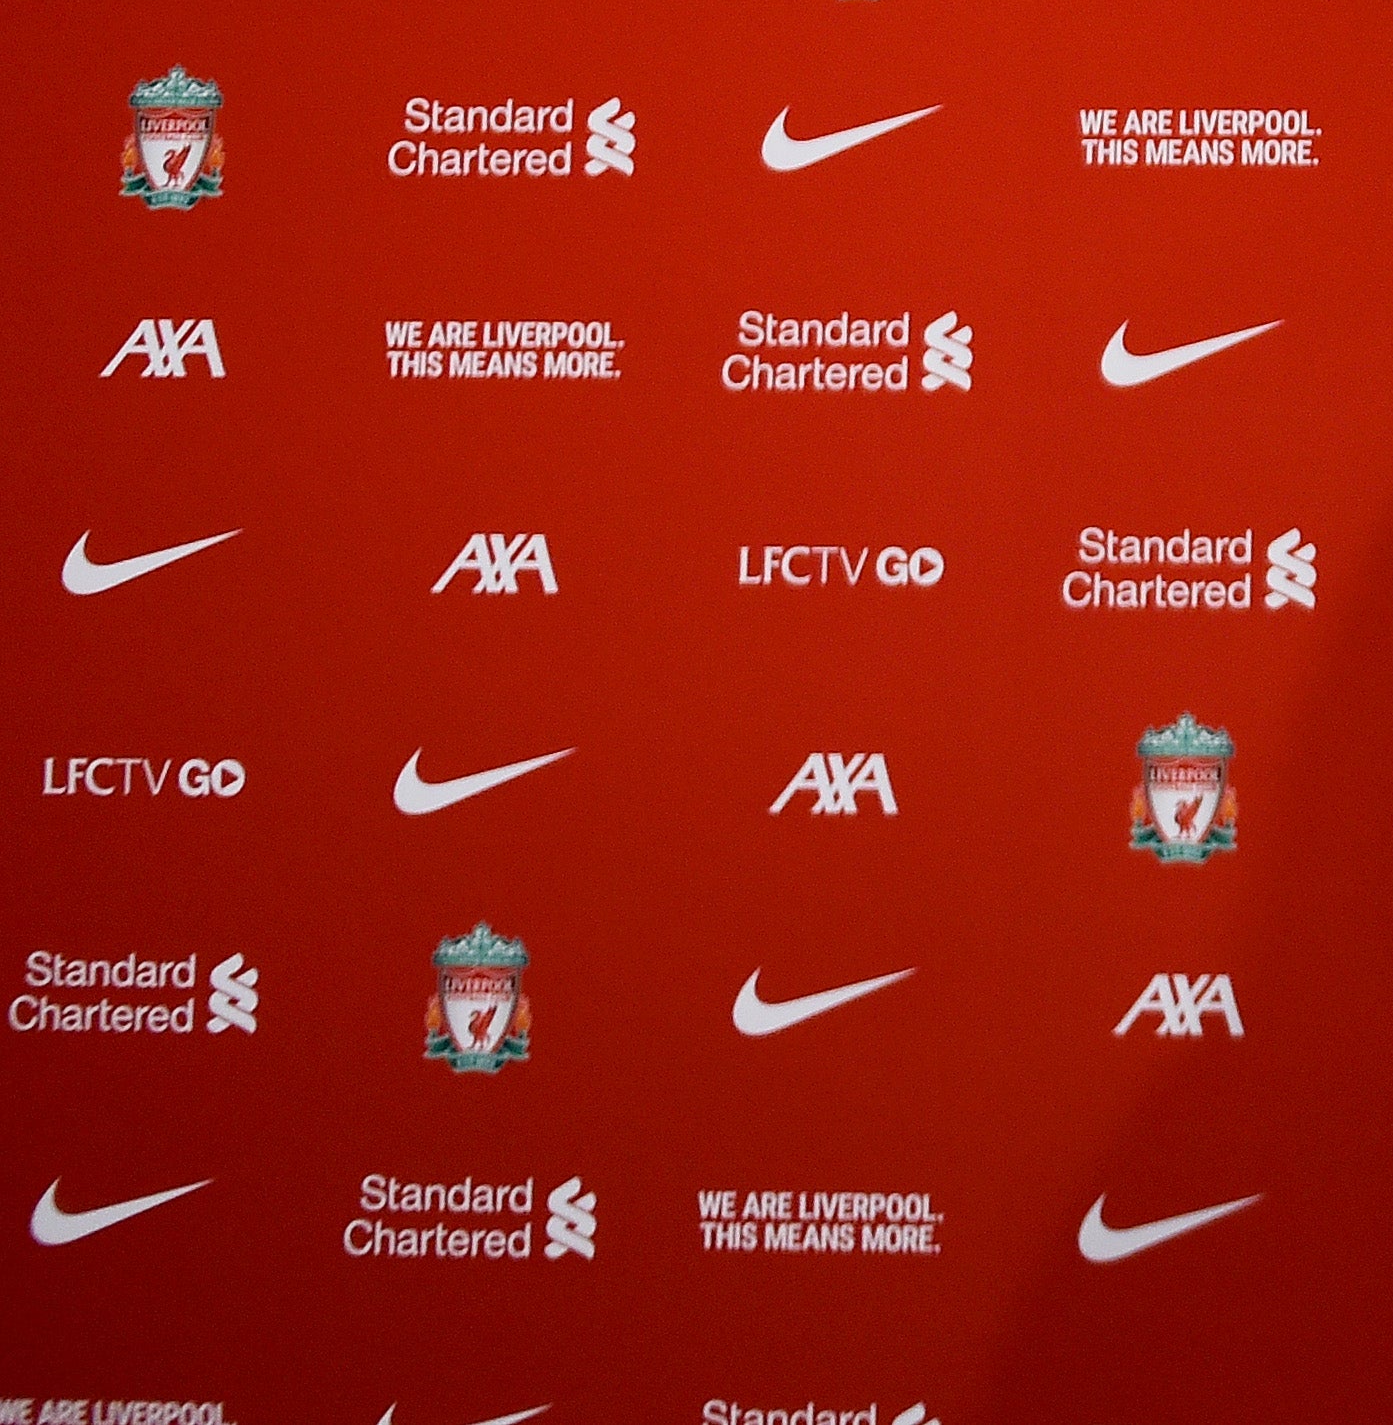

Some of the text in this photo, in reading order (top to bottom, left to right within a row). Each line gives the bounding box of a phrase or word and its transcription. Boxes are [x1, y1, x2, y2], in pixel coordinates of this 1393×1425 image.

[404, 98, 573, 134] Standard
[1078, 109, 1322, 137] WE ARE LIVERPOOL.
[388, 140, 572, 177] Chartered
[1081, 139, 1319, 167] THIS MEANS MORE.
[385, 321, 625, 349] WE ARE LIVERPOOL.
[738, 310, 910, 348] Standard
[99, 319, 226, 378] AXA
[386, 350, 621, 379] THIS MEANS MORE.
[722, 354, 908, 392] Chartered
[431, 533, 559, 595] AXA
[1079, 527, 1252, 565] Standard
[1062, 571, 1251, 609] Chartered
[769, 753, 898, 816] AXA
[26, 951, 196, 988] Standard
[8, 995, 194, 1033] Chartered
[1112, 973, 1244, 1037] AXA
[360, 1174, 533, 1213] Standard
[698, 1190, 944, 1221] WE ARE LIVERPOOL.
[344, 1219, 531, 1258] Chartered
[700, 1221, 942, 1254] THIS MEANS MORE.
